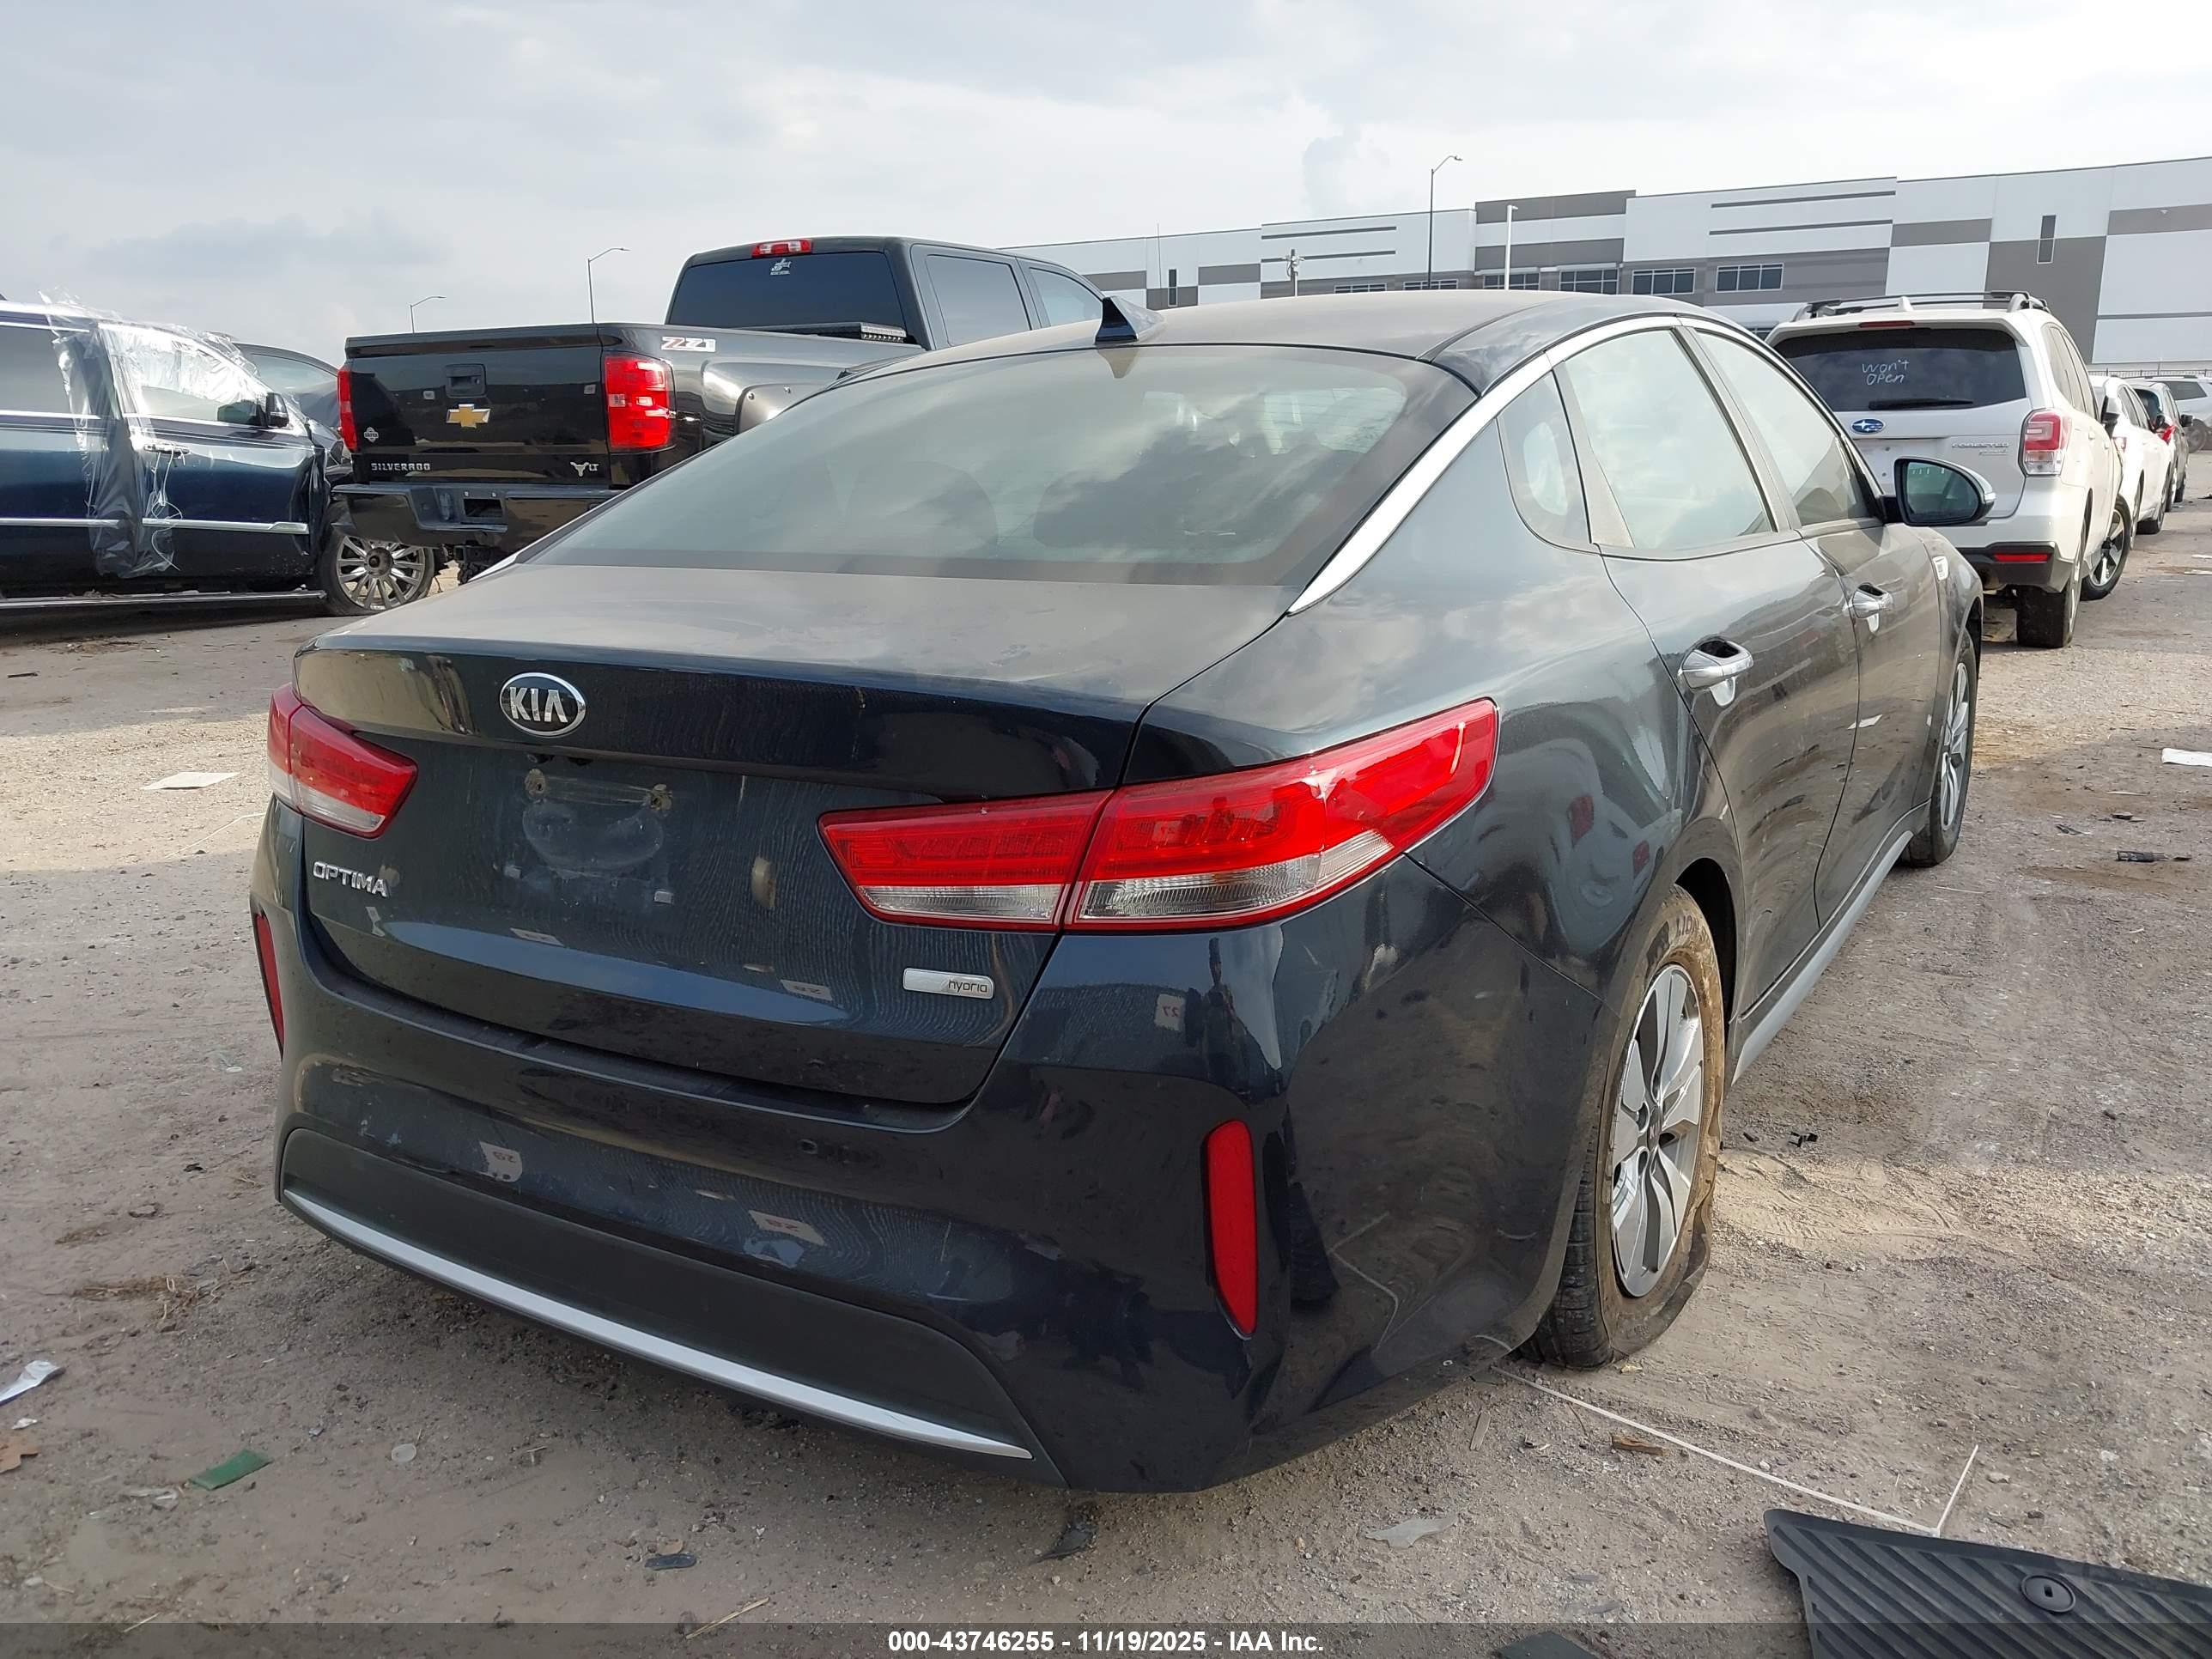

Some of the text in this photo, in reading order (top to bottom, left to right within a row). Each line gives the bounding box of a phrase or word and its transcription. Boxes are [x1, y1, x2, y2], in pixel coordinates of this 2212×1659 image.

[661, 336, 716, 352] Z71
[509, 686, 568, 723] KIA
[313, 861, 389, 897] OPTIMA
